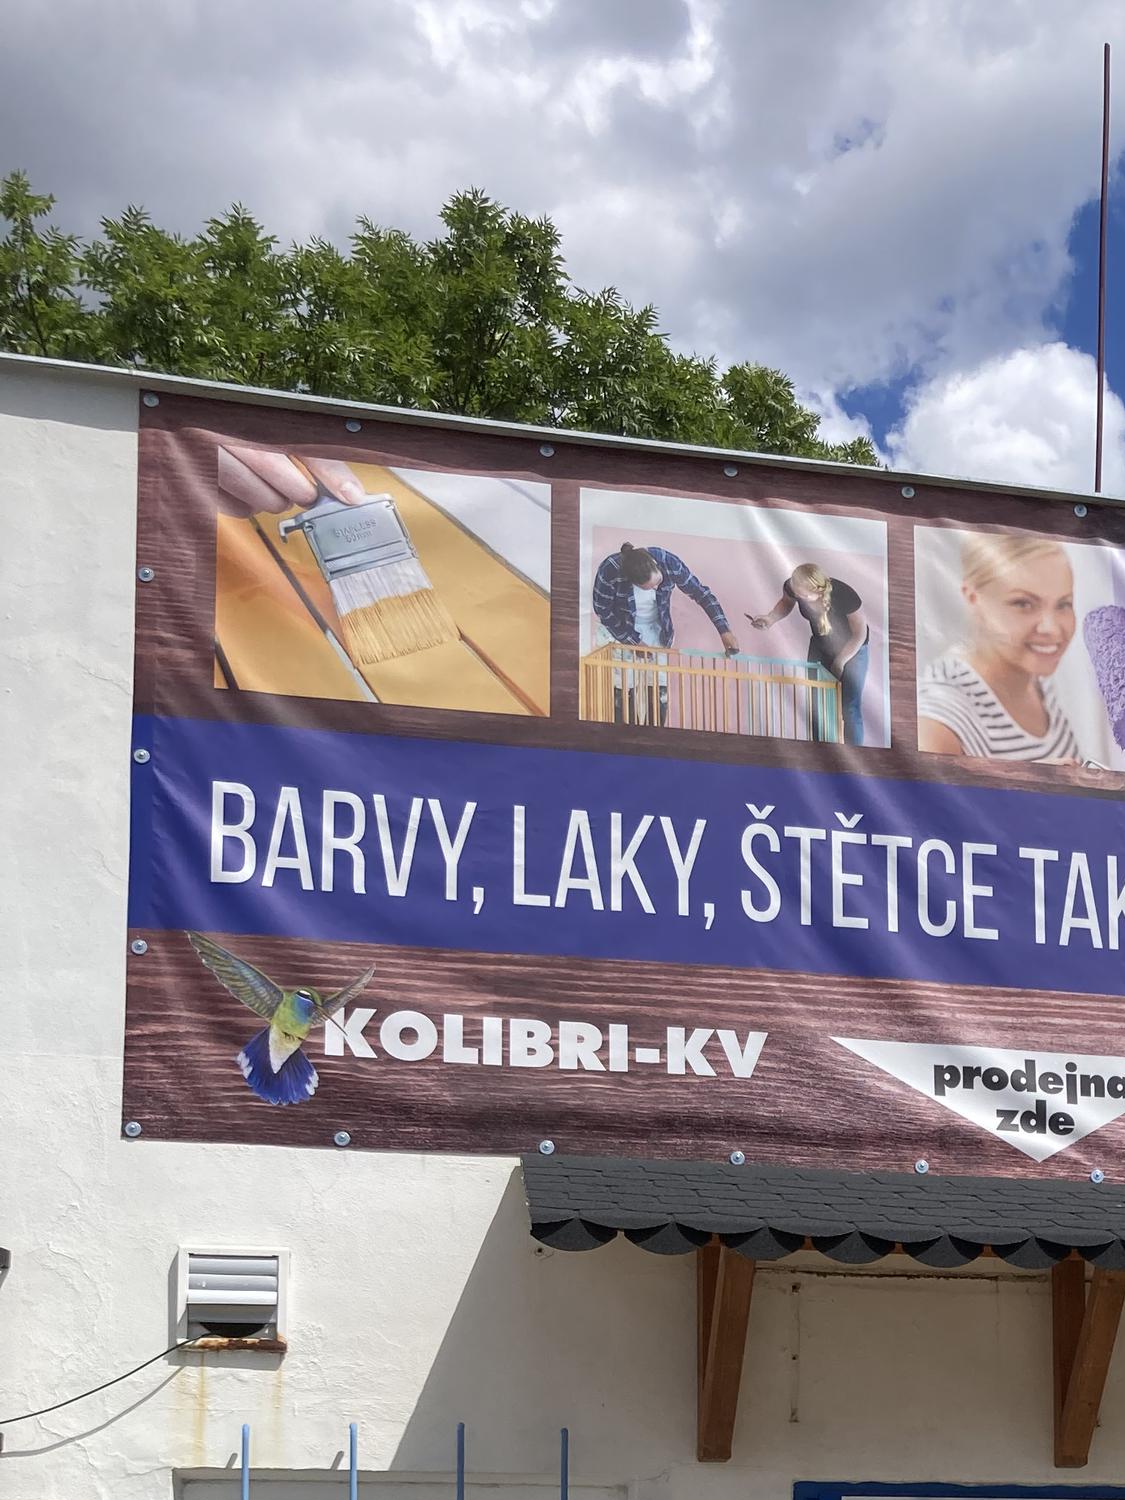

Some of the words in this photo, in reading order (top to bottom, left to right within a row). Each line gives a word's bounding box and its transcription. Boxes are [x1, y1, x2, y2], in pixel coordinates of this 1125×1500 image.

[209, 780, 486, 916] BARVY,
[511, 804, 716, 931] LAKY,
[740, 803, 999, 944] ŠTĚTCE
[321, 1006, 769, 1079] KOLIBRI-KV
[995, 1100, 1076, 1138] zde
